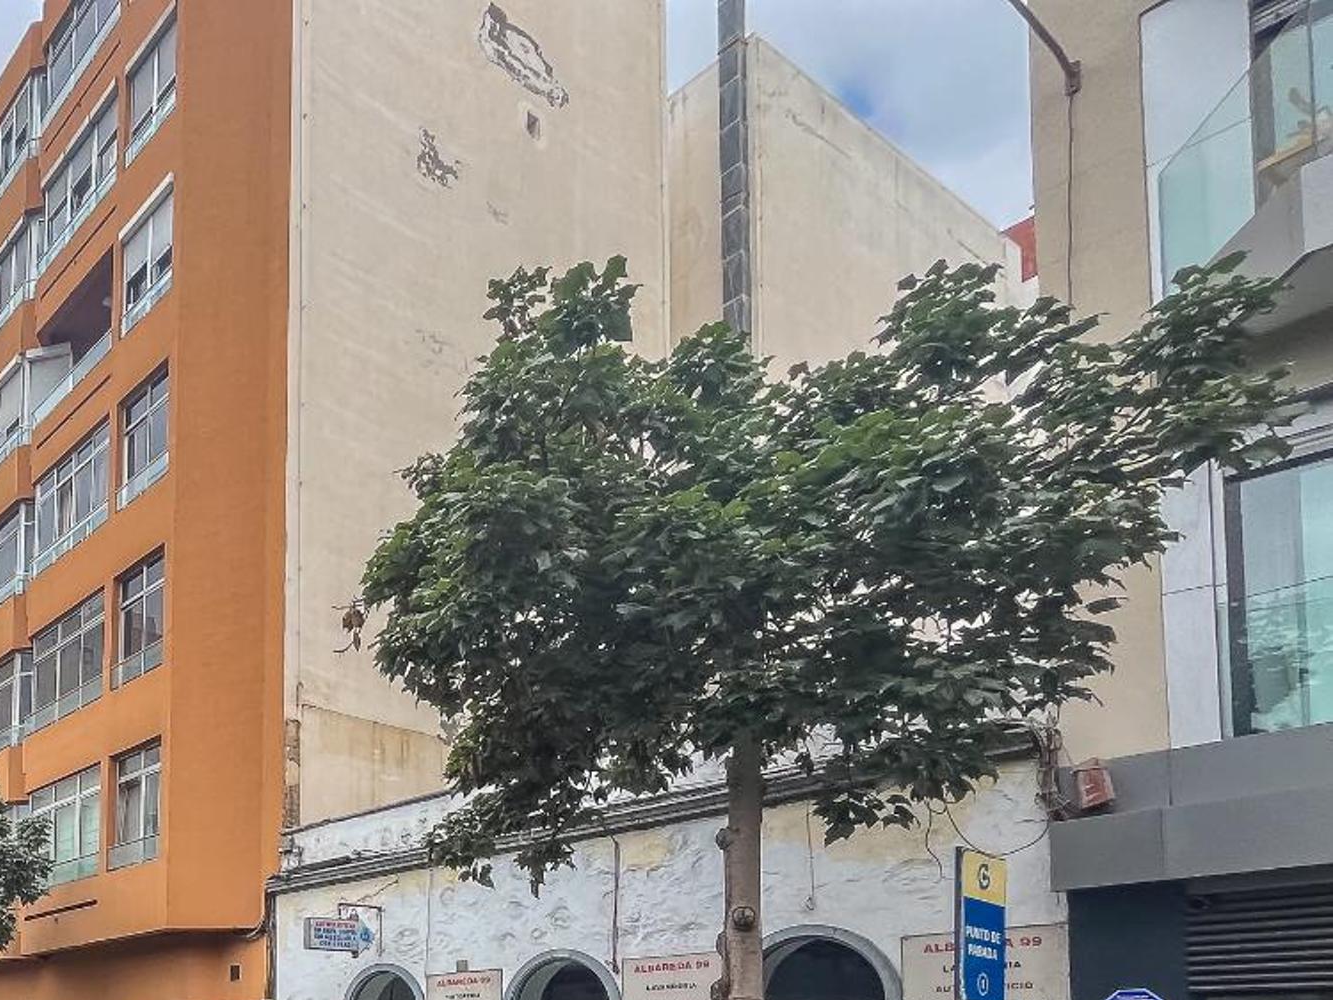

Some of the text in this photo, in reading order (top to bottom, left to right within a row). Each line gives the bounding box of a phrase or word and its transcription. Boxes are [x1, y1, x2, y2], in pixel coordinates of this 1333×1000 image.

[966, 925, 1001, 944] PUNTO DE
[1020, 936, 1042, 947] 99
[968, 944, 997, 961] PARADA
[634, 961, 692, 973] ALBAREDA
